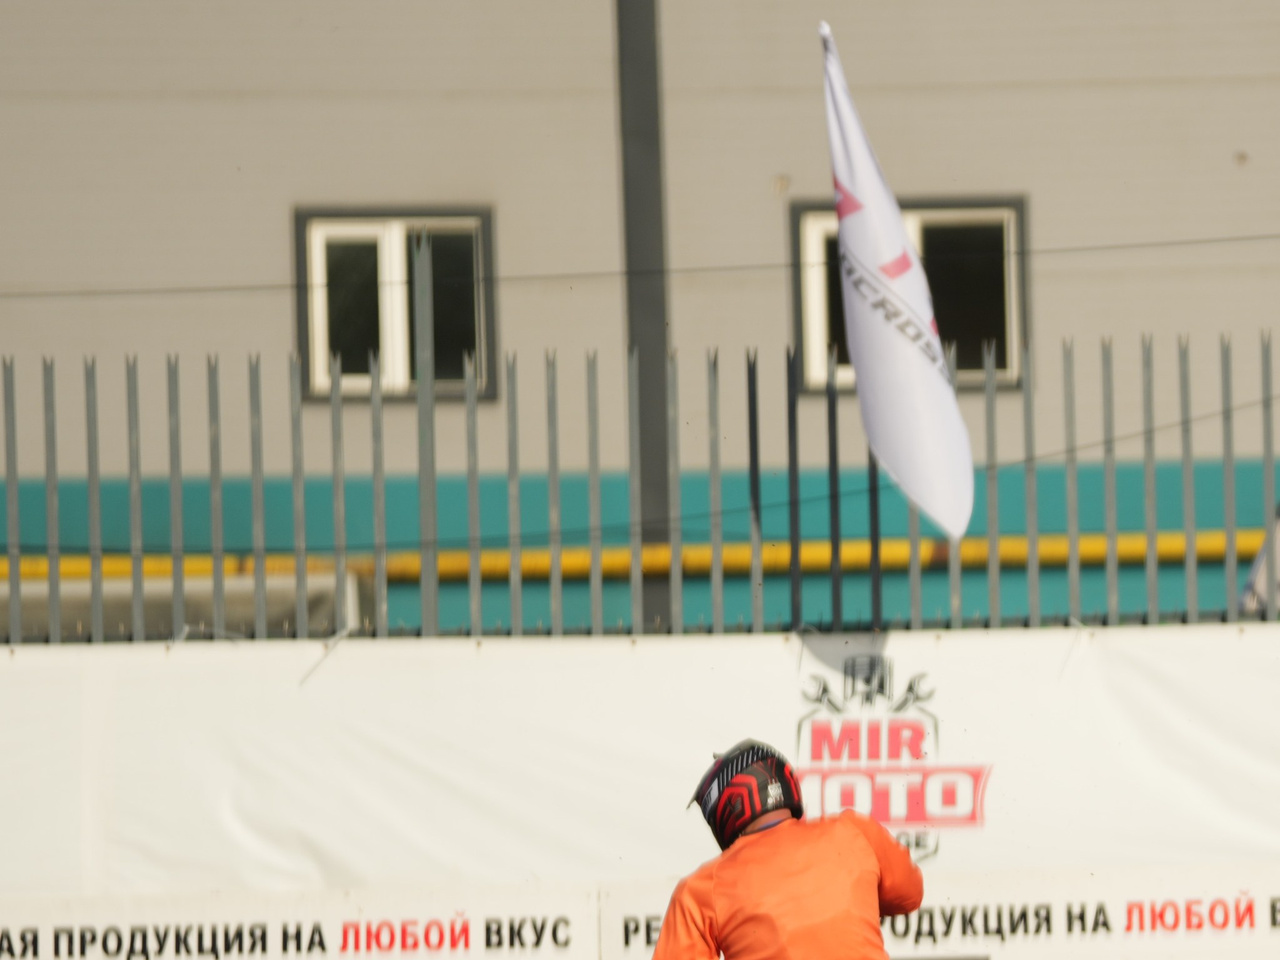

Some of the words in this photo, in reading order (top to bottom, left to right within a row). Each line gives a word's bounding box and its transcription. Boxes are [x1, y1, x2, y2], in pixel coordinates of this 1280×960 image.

[810, 719, 926, 761] MIR
[282, 922, 327, 954] НА
[339, 911, 471, 953] ЛЮБОЙ
[485, 916, 572, 950] ВКУС
[880, 903, 1052, 944] ОДУКЦИЯ
[1066, 903, 1113, 936] НА
[1125, 890, 1256, 933] ЛЮБОЙ
